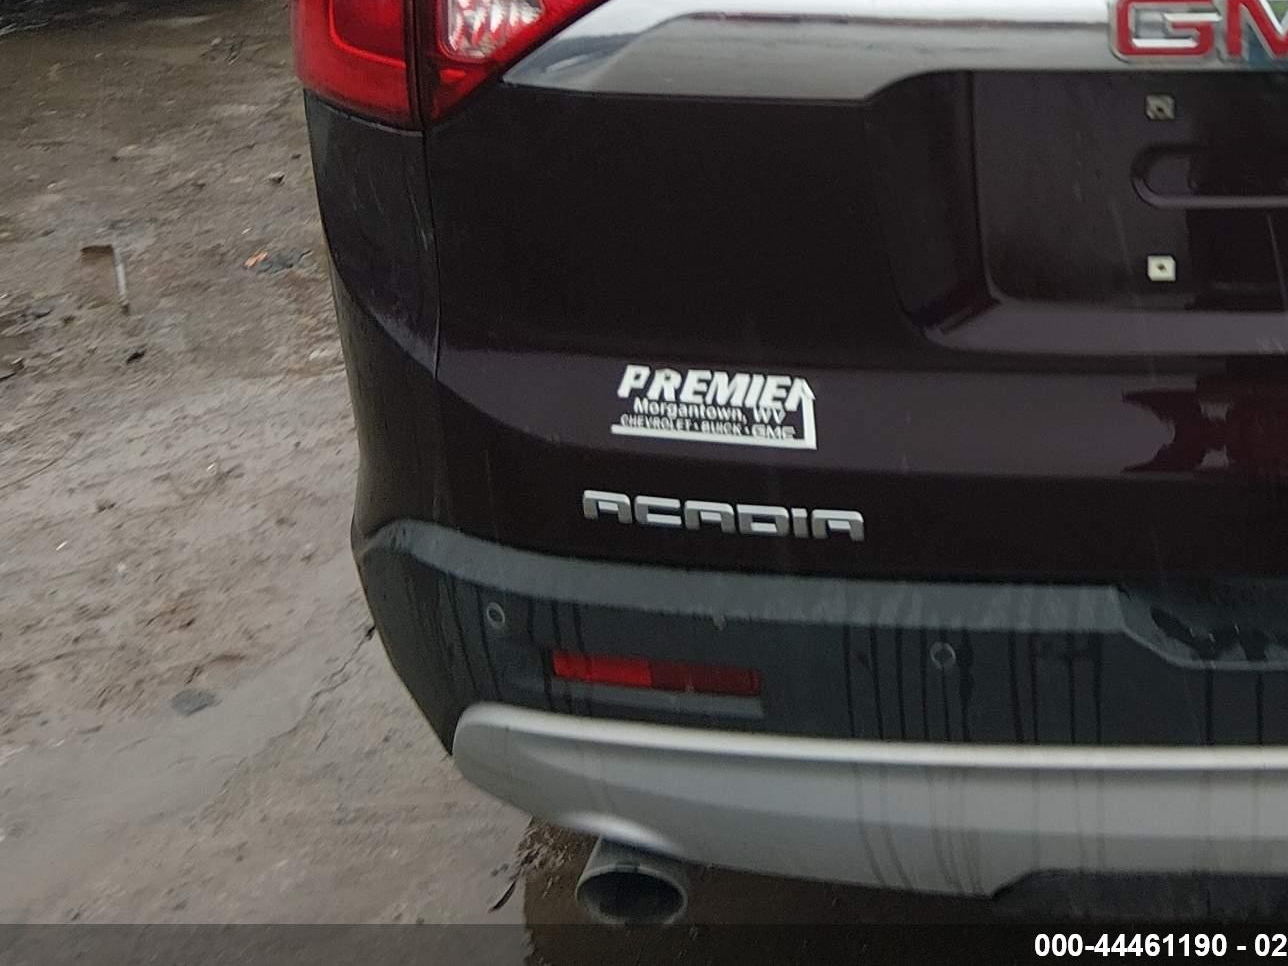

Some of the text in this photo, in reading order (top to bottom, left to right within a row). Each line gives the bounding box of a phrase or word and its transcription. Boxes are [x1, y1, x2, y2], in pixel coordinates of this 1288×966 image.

[634, 397, 786, 424] Morgantown, WV
[620, 414, 692, 431] CHEVROLET
[700, 421, 741, 435] BUICK
[582, 490, 864, 541] ACADIA
